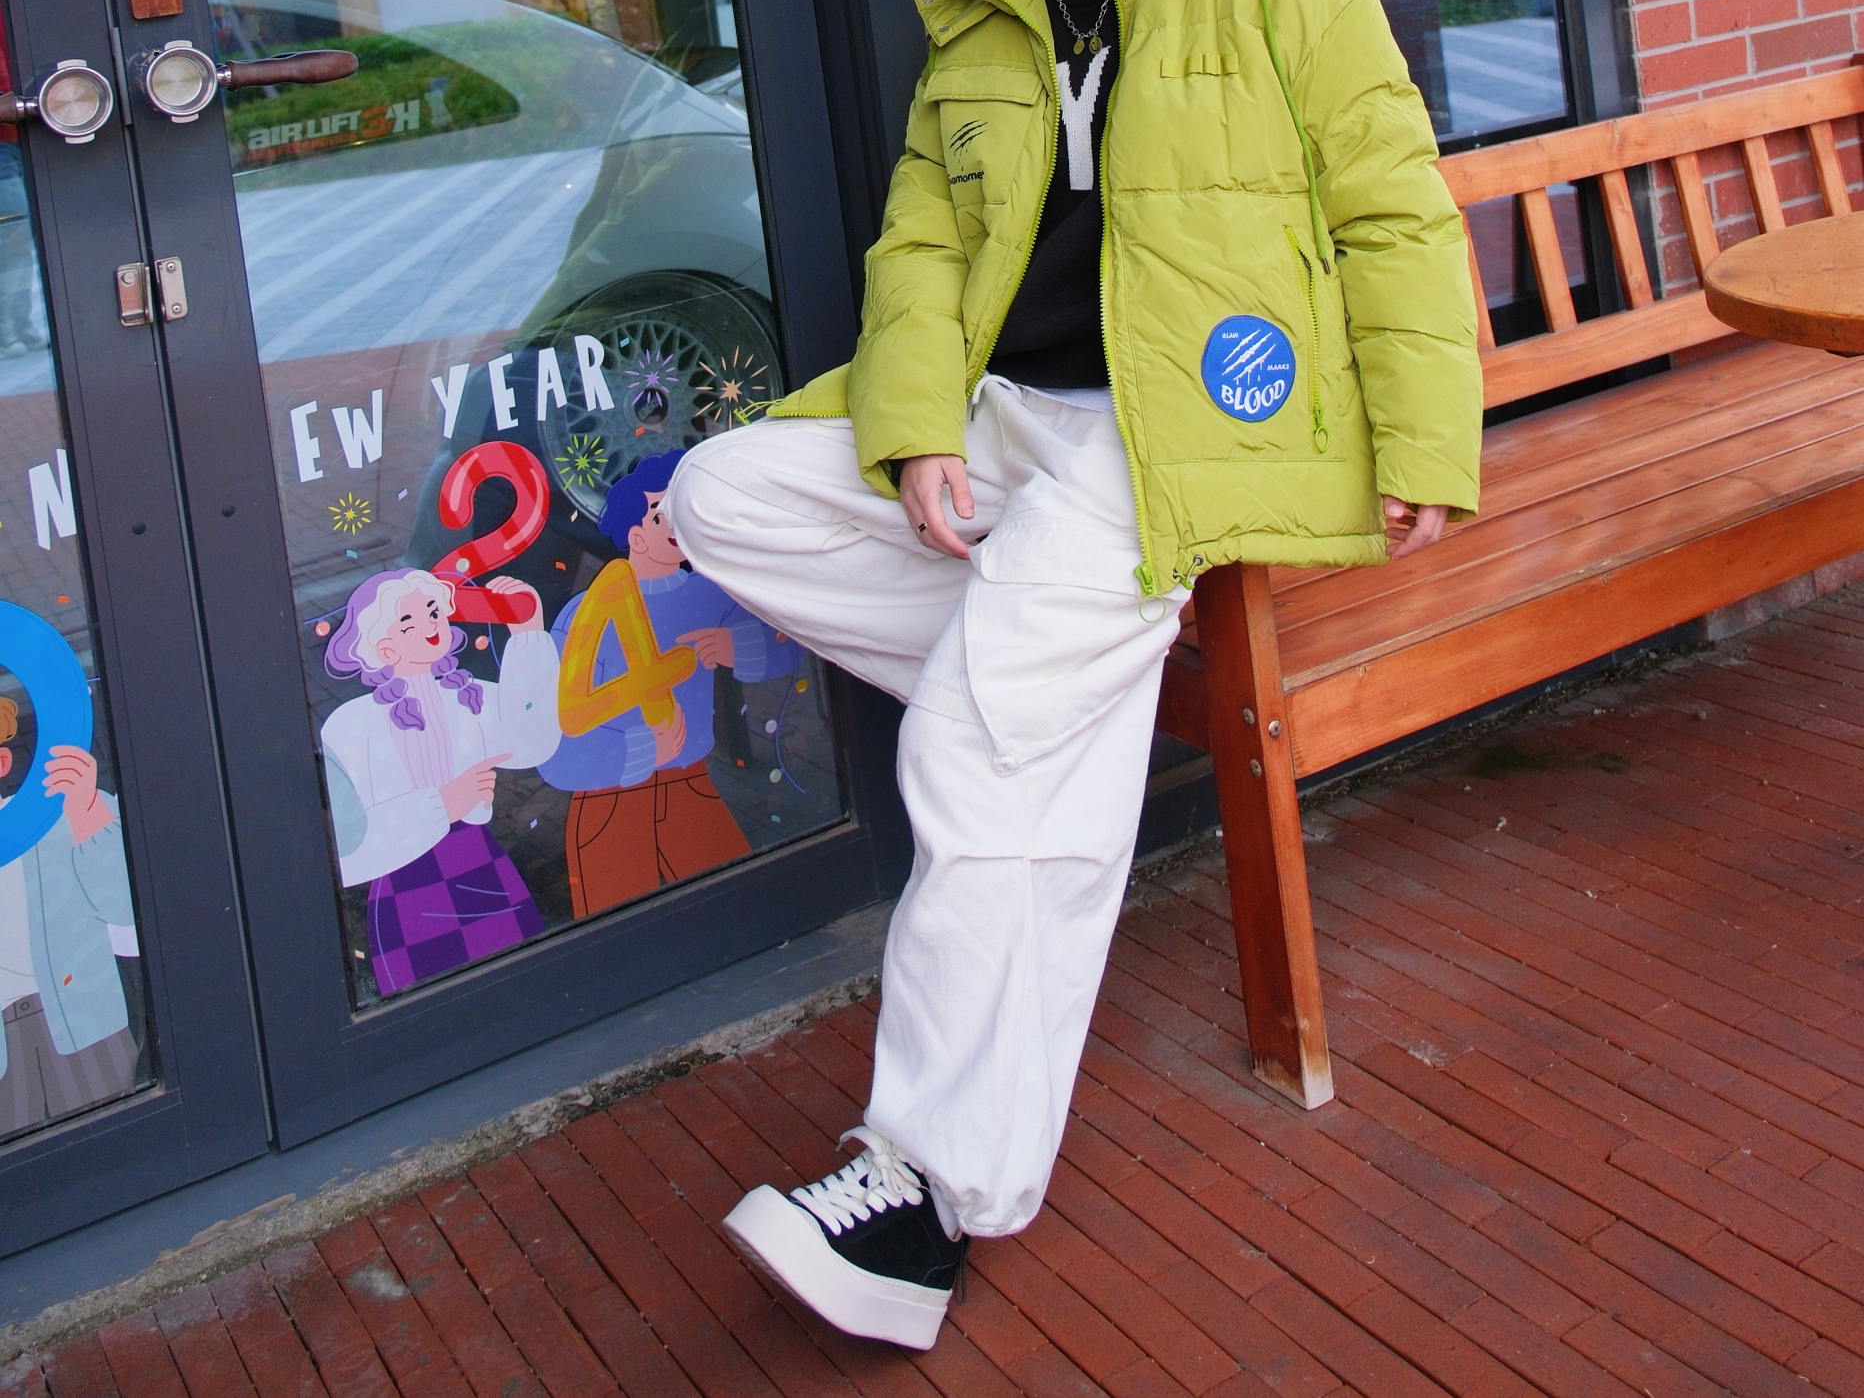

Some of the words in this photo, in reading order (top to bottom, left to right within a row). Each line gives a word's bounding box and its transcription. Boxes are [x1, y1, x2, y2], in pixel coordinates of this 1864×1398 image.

[1057, 45, 1111, 191] Y
[430, 334, 616, 439] YEAR
[1221, 379, 1285, 414] BLOOD
[1267, 363, 1290, 371] MARKS
